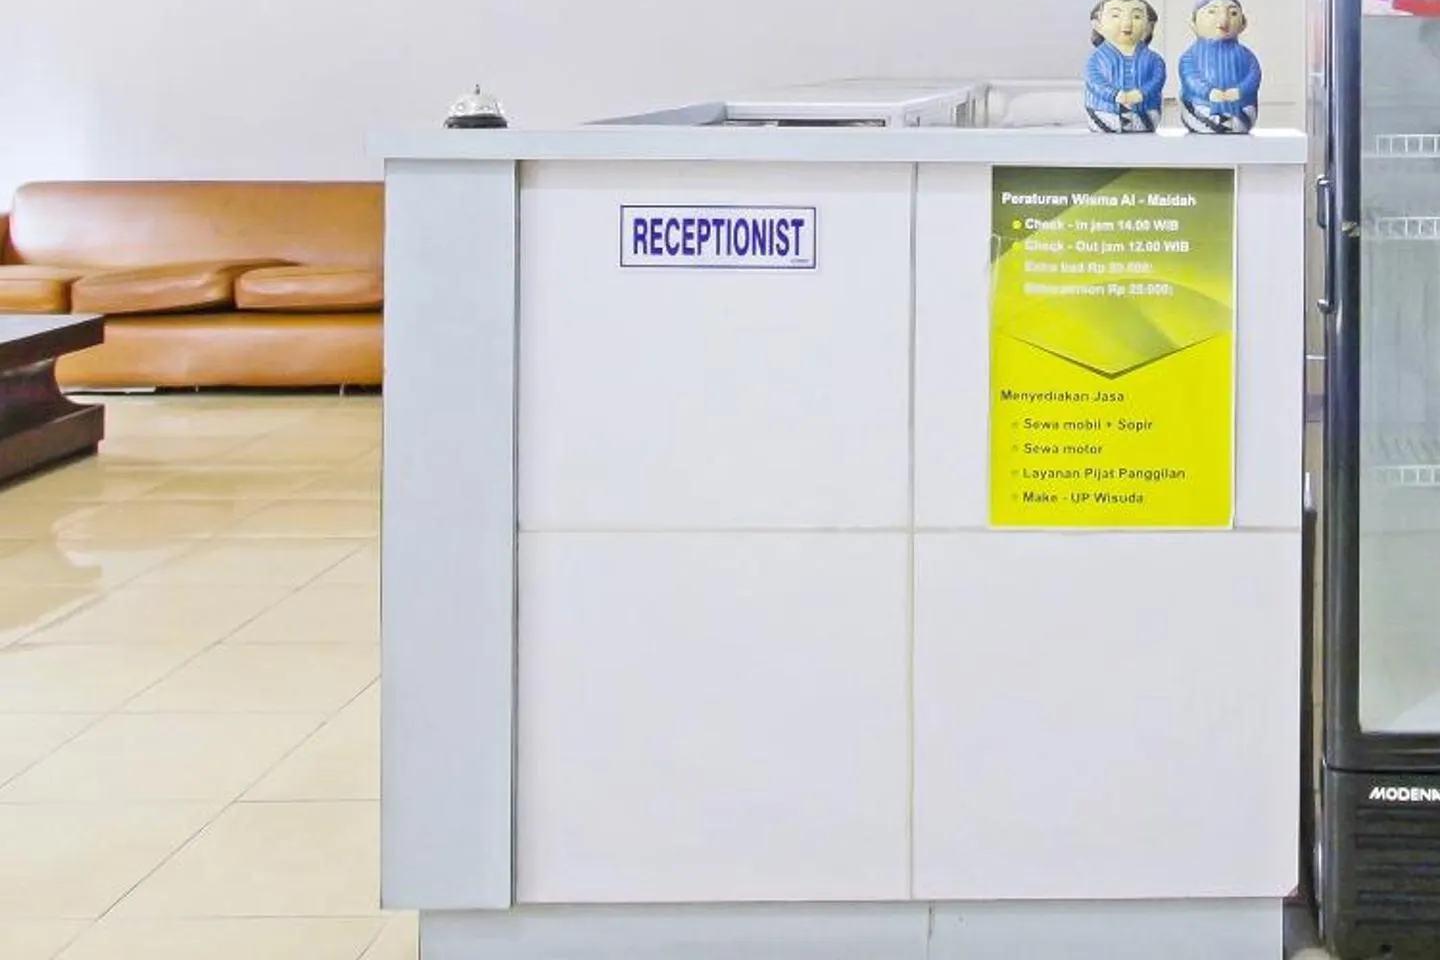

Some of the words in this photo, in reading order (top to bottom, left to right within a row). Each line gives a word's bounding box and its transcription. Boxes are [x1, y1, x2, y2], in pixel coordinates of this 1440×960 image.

[1001, 192, 1068, 205] Peraturan
[1071, 193, 1118, 206] Wisma
[1147, 194, 1197, 207] Maidah
[1025, 218, 1064, 230] Check
[1090, 220, 1114, 233] jam
[1119, 220, 1151, 231] 14.00
[1153, 220, 1179, 231] WIB
[633, 217, 804, 256] RECEPTIONIST
[1025, 240, 1064, 252] Check
[1076, 241, 1099, 252] Out
[1101, 241, 1125, 255] jam
[1129, 242, 1161, 252] 12.00
[1164, 242, 1190, 252] WIB
[1000, 390, 1089, 403] Menyediakan
[1094, 391, 1125, 402] Jasa
[1024, 418, 1059, 430] Sewa
[1063, 418, 1101, 430] mobil
[1117, 419, 1153, 431] Sopir
[1024, 443, 1059, 454] Sewa
[1063, 444, 1102, 454] motor
[1023, 468, 1080, 481] Layanan
[1084, 468, 1115, 481] Pijat
[1119, 468, 1186, 481] Panggilan
[1023, 492, 1058, 503] Make
[1071, 493, 1090, 504] UP
[1094, 492, 1144, 504] Wisuda
